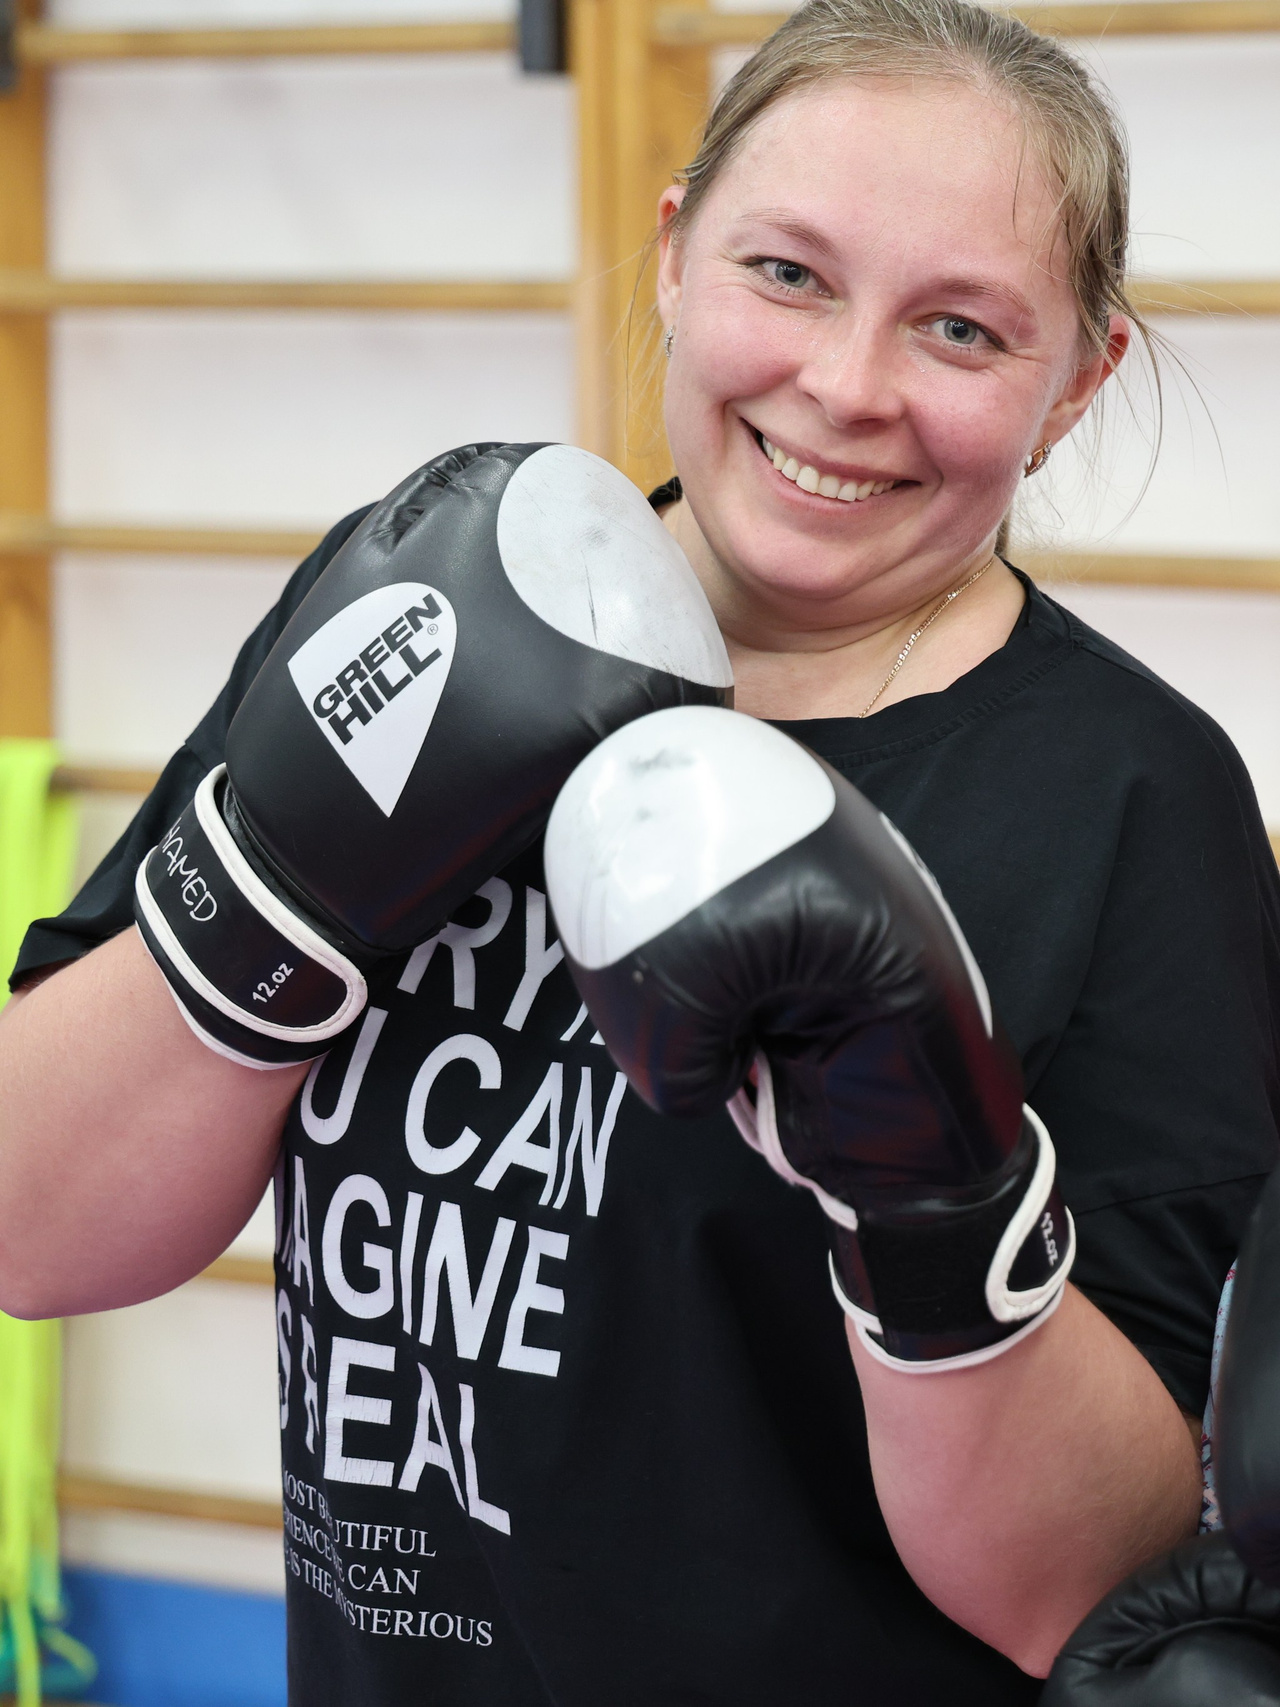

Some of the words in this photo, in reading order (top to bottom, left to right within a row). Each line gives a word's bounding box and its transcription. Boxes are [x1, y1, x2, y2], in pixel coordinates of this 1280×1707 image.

[312, 593, 442, 719] GREEN
[326, 647, 442, 745] HILL
[300, 1006, 389, 1145] U
[404, 1033, 628, 1217] CAN
[275, 1150, 570, 1378] AGINE
[284, 1469, 317, 1511] OST
[302, 1558, 334, 1598] THE
[348, 1563, 421, 1596] CAN
